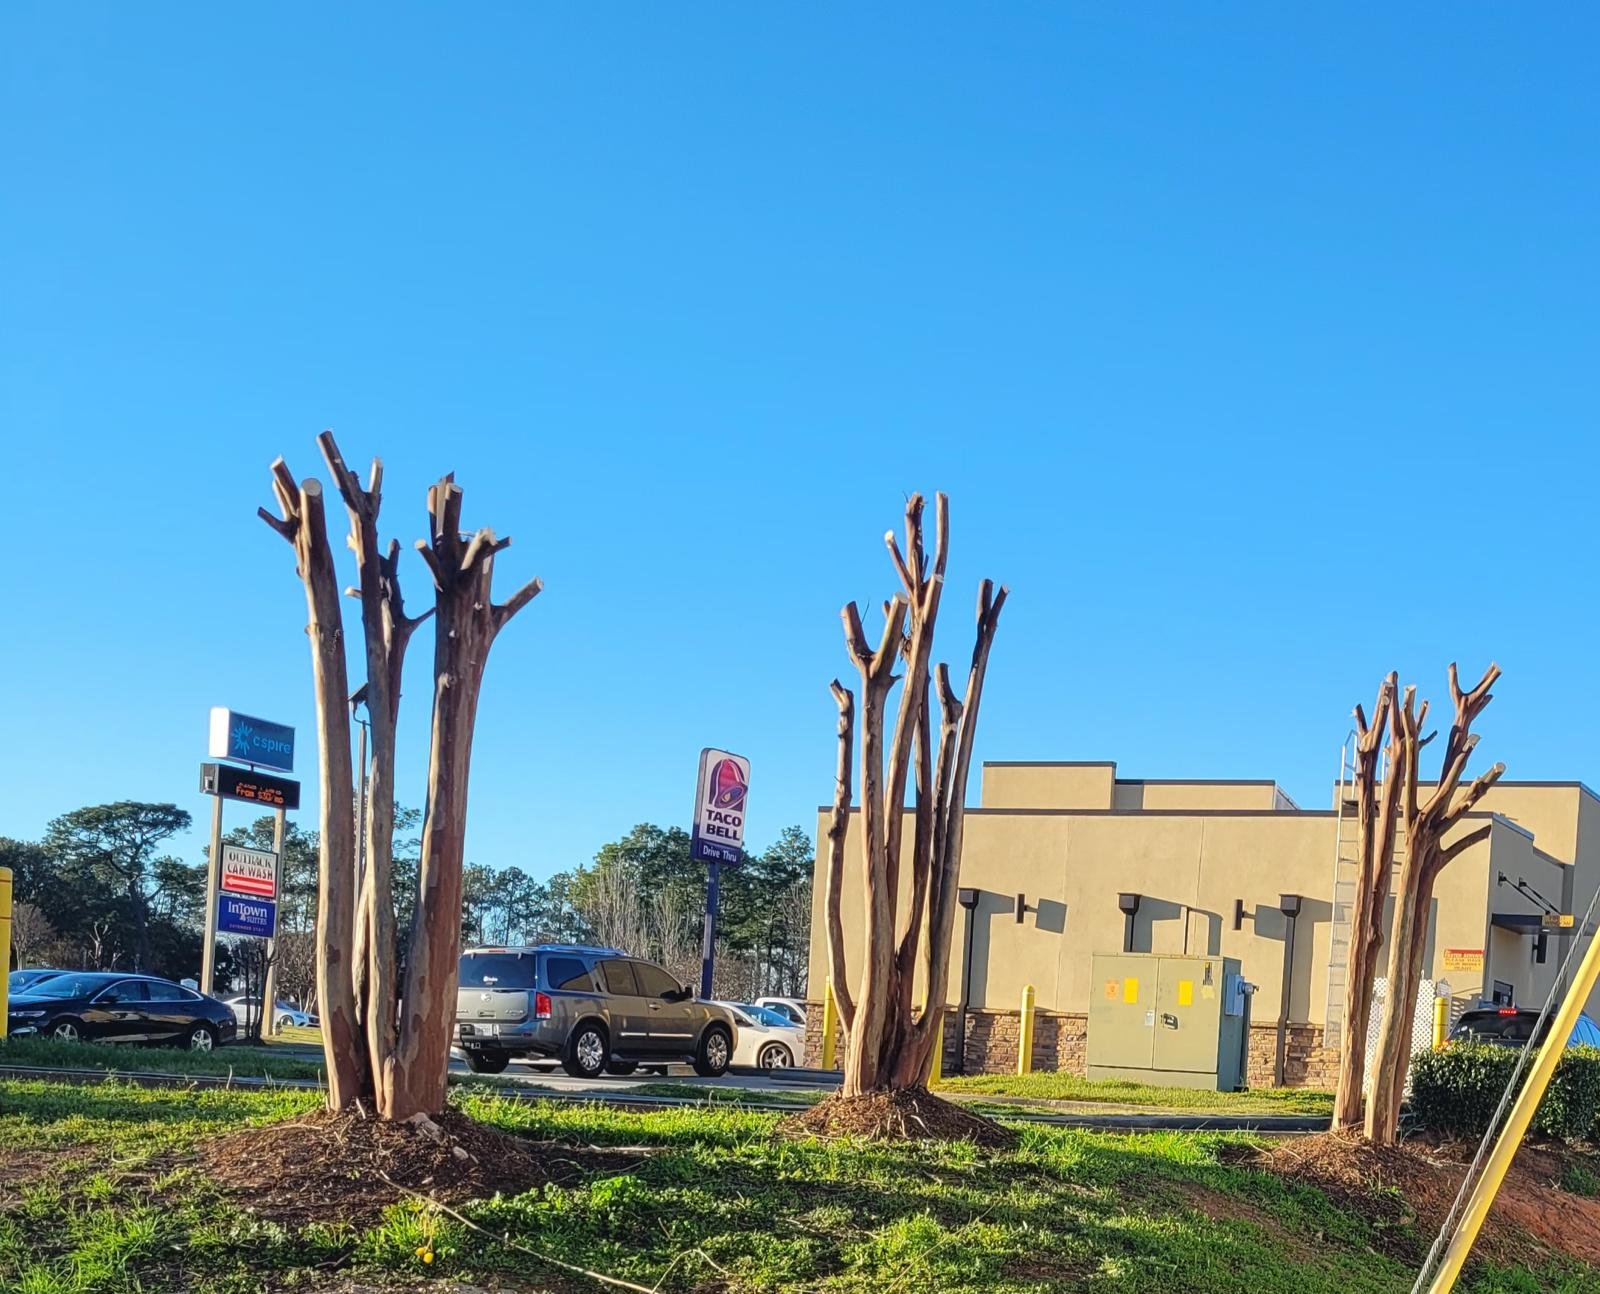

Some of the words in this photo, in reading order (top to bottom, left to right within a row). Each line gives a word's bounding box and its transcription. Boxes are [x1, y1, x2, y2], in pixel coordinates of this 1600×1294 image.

[706, 809, 742, 827] TACO
[706, 823, 740, 841] BELL
[229, 852, 272, 868] OUTBACK
[703, 845, 720, 859] Drive
[723, 850, 737, 862] Thru
[227, 863, 244, 875] CAR
[248, 867, 273, 880] WASH
[228, 901, 268, 918] InTown
[246, 915, 267, 926] SUITES
